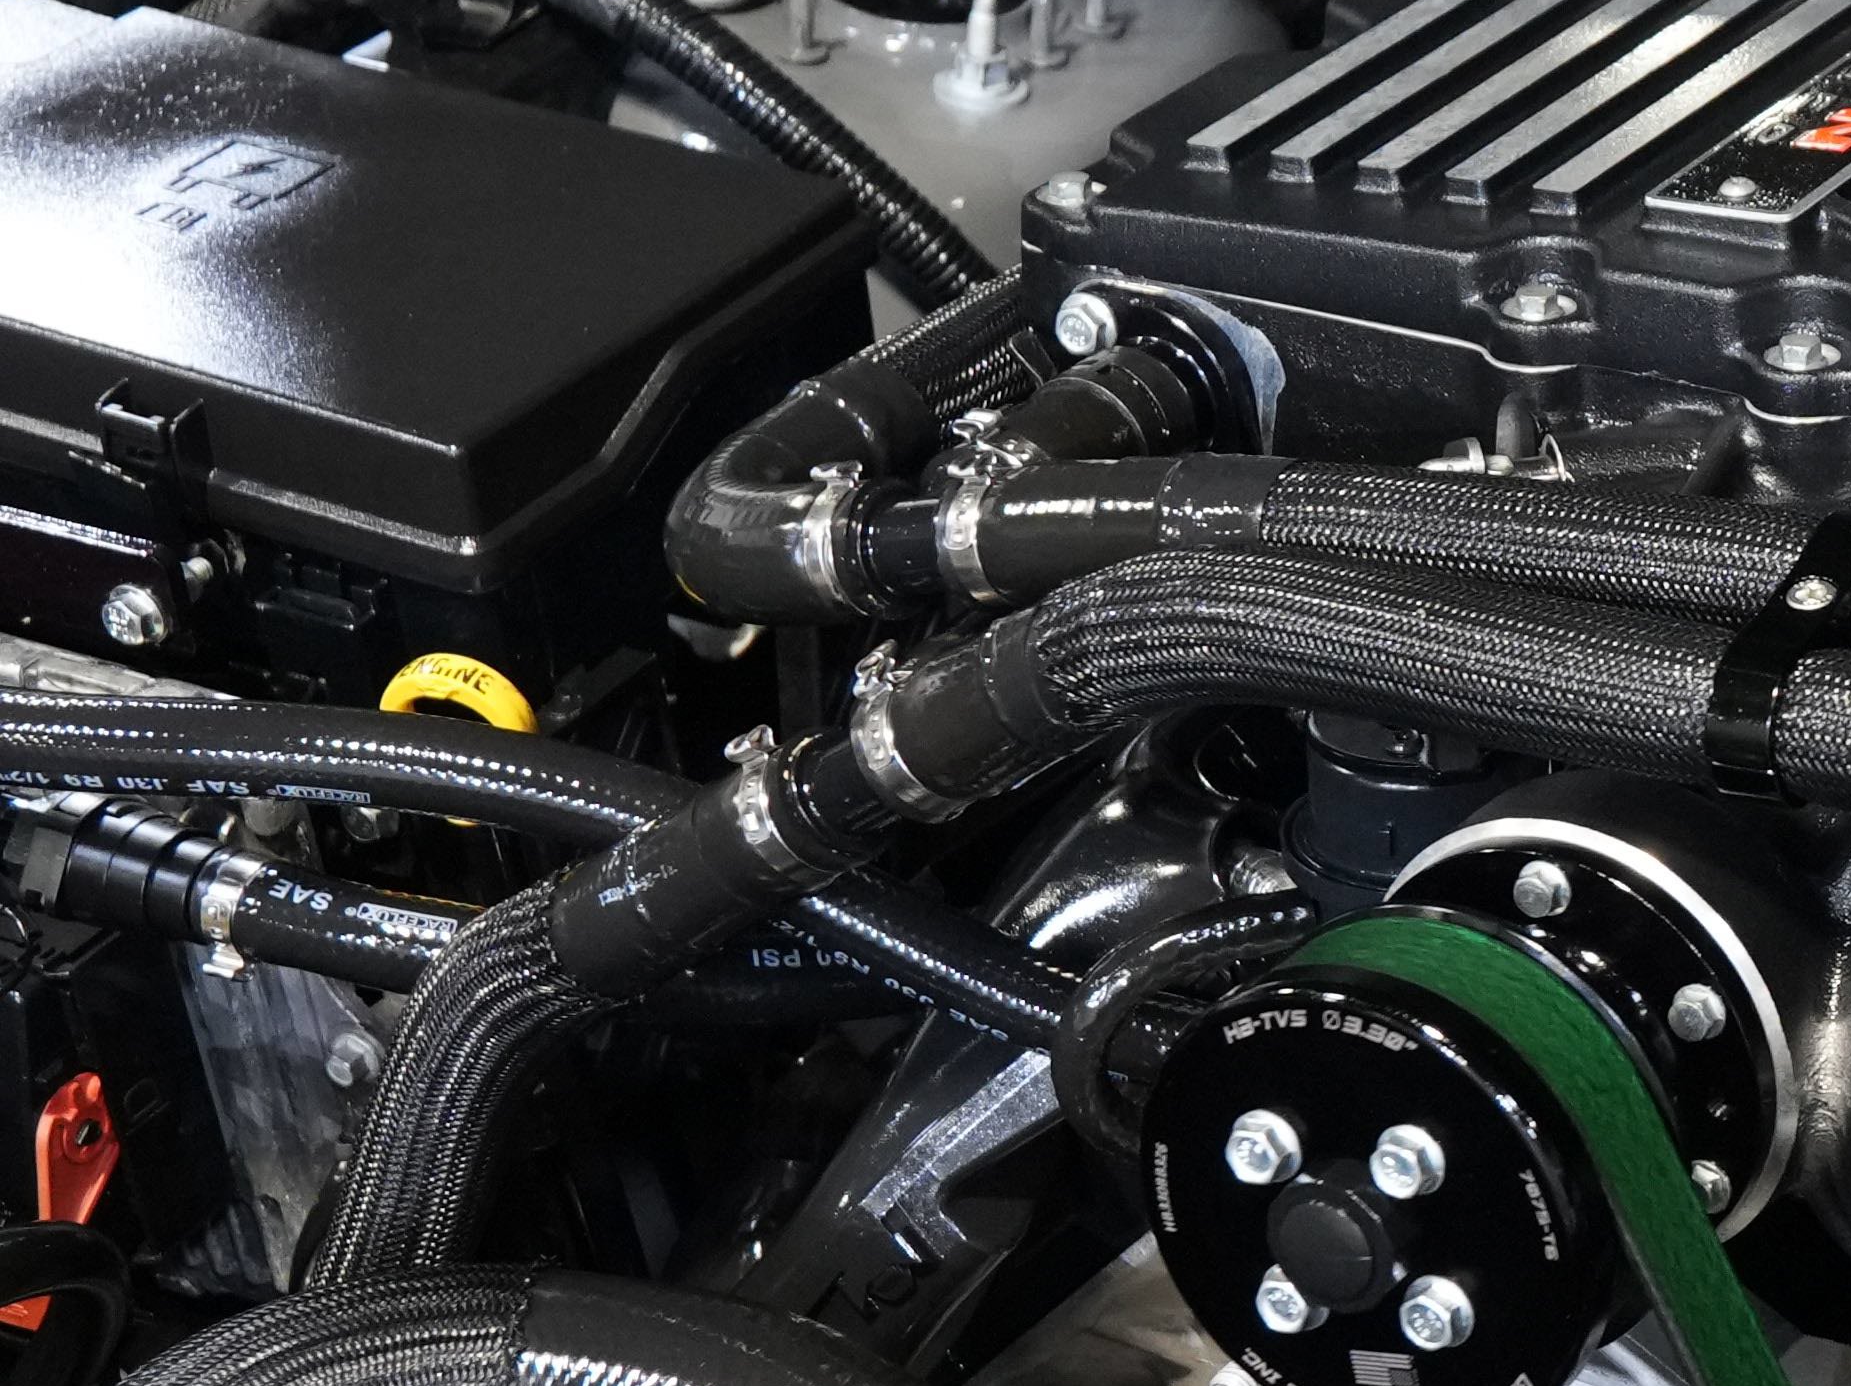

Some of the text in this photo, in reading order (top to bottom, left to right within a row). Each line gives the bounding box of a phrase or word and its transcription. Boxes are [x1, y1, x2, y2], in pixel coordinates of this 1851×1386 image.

[398, 656, 493, 694] ENGINE
[267, 876, 334, 912] SAE
[751, 948, 802, 969] PSI
[1239, 1345, 1284, 1386] INC.
